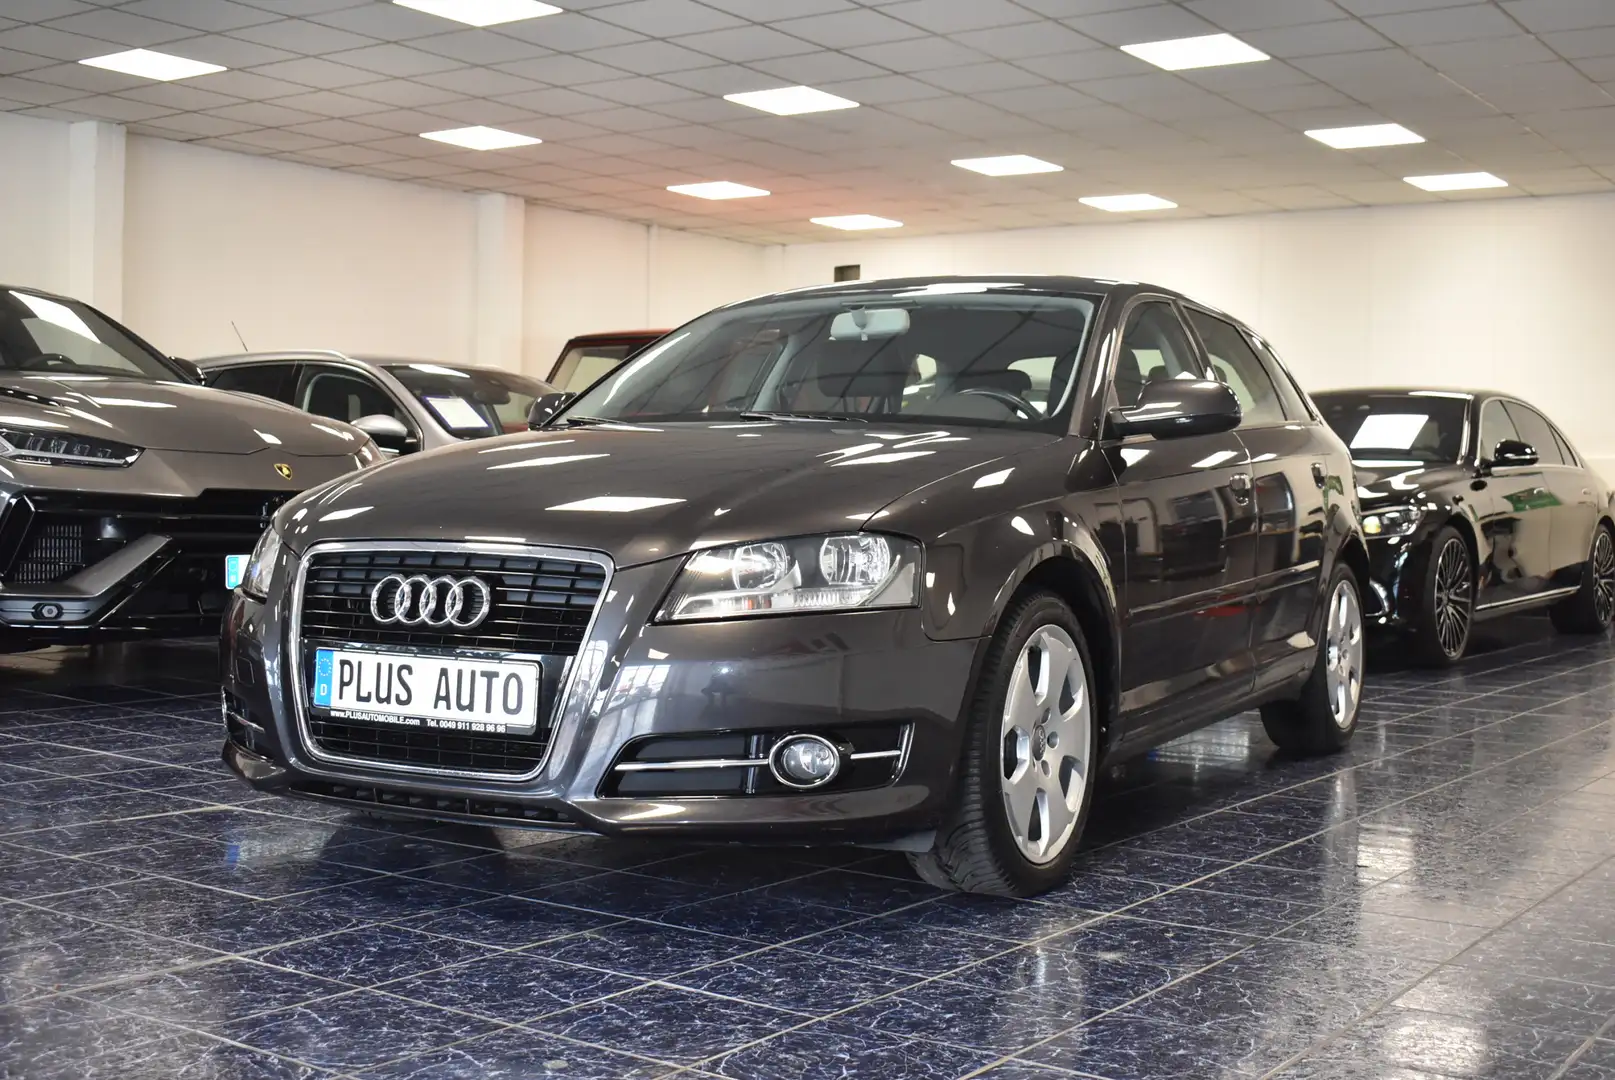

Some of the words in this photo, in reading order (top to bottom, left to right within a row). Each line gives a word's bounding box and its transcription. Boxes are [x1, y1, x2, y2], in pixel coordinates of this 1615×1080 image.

[320, 683, 328, 696] D
[339, 659, 413, 706] PLUS
[433, 667, 523, 715] AUTO
[426, 719, 438, 728] Tel.
[439, 720, 456, 729] 0049
[457, 722, 470, 731] 911
